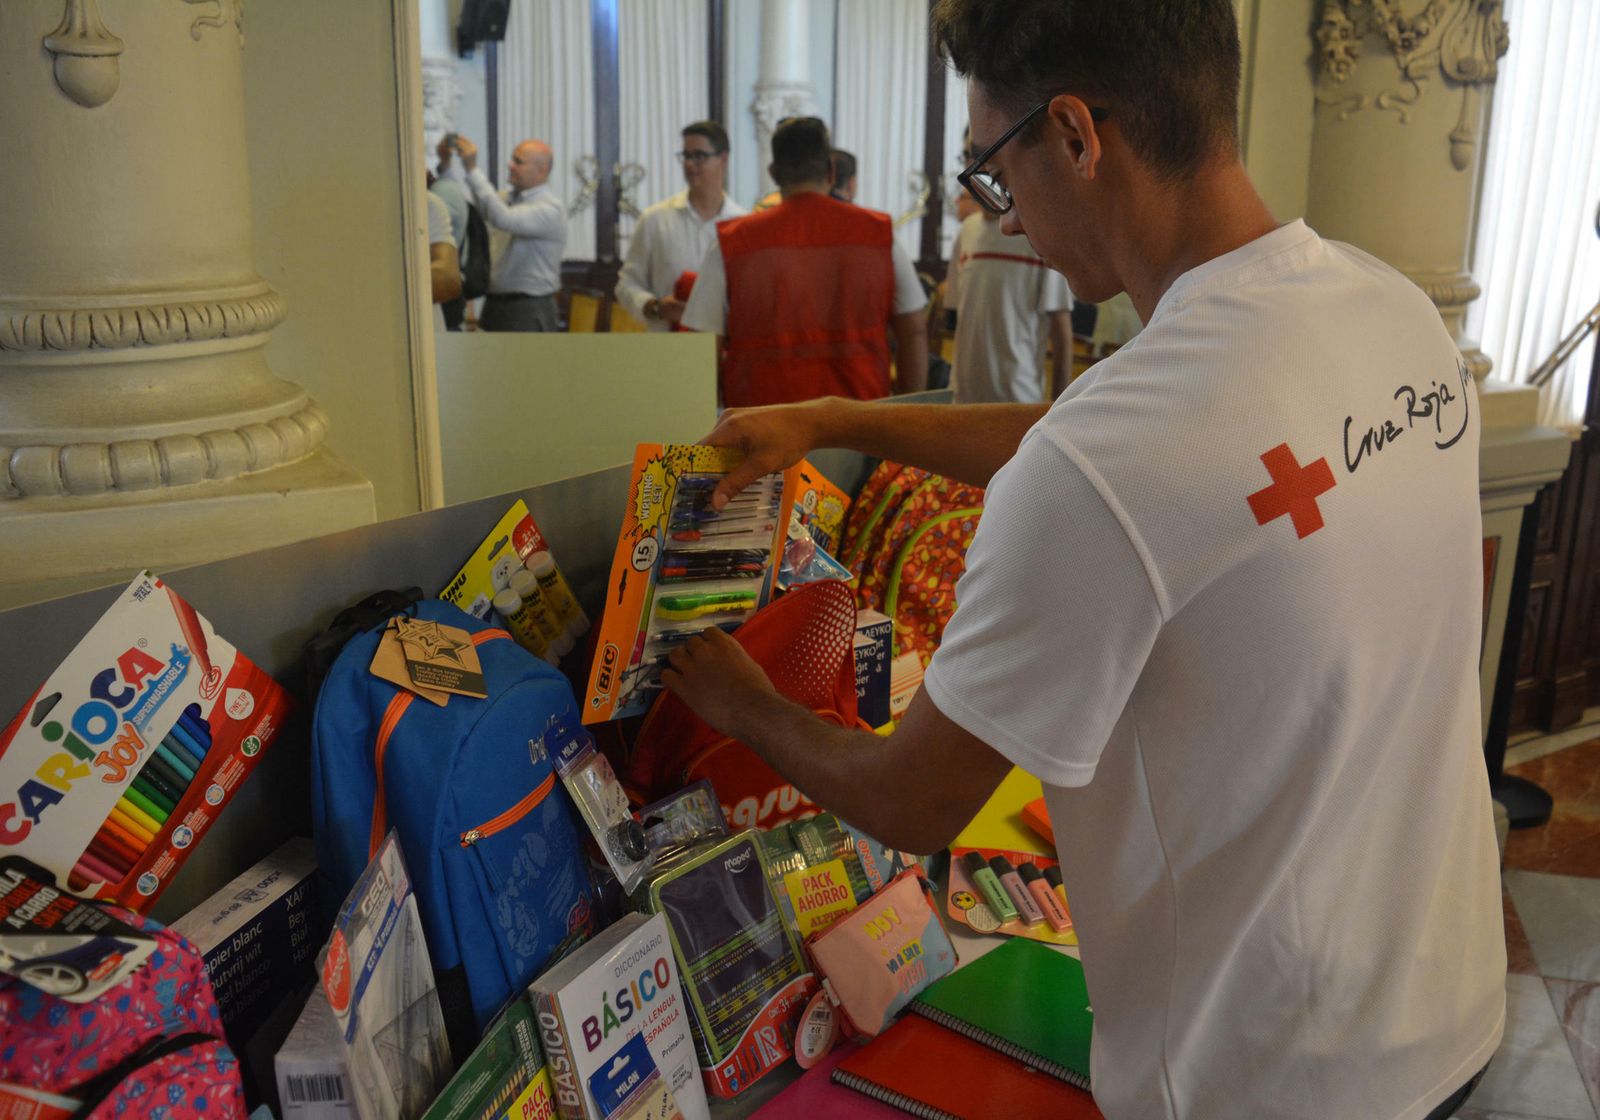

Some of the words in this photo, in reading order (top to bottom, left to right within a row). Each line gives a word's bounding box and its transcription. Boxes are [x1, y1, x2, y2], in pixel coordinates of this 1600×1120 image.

[1344, 416, 1404, 473] Cruz
[1394, 381, 1456, 433] Roja
[640, 475, 654, 521] WRITING
[653, 486, 663, 505] SET
[635, 545, 650, 566] 15
[442, 573, 467, 603] UHU
[132, 660, 186, 726] SUPERWASHABLE
[0, 646, 166, 846] CARIOCA
[95, 722, 146, 785] JOY
[724, 848, 752, 872] Maped
[360, 871, 386, 916] GEO
[799, 884, 849, 913] AHORRO
[802, 870, 835, 892] PACK
[5, 910, 23, 930] A
[16, 887, 60, 922] CARRO
[33, 894, 80, 929] SAFTA
[864, 905, 903, 941] HOY
[233, 920, 264, 954] blanc
[243, 942, 263, 967] wit
[614, 934, 663, 979] DICCIONARIO
[581, 956, 671, 1053] BÁSICO
[649, 994, 677, 1024] LENGUA
[644, 1008, 681, 1048] ESPAÑOLA
[661, 1033, 686, 1058] Primaria
[521, 1081, 547, 1117] PACK
[615, 1070, 641, 1099] MILAN
